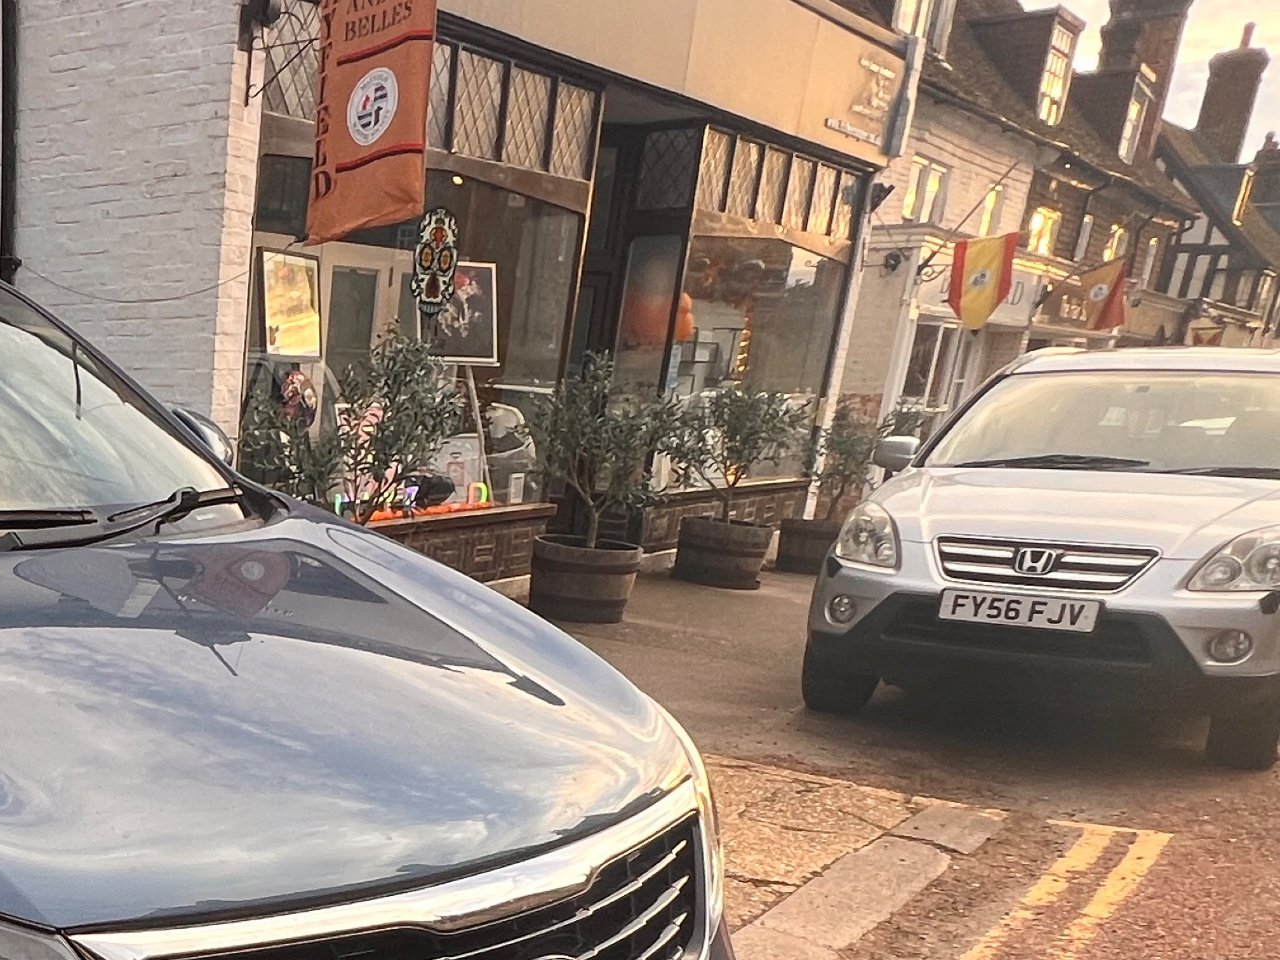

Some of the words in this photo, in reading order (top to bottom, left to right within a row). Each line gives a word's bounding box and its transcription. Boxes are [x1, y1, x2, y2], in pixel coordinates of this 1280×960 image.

[344, 0, 412, 41] BELLES
[950, 594, 1021, 621] FY56
[1027, 601, 1087, 627] FJV
